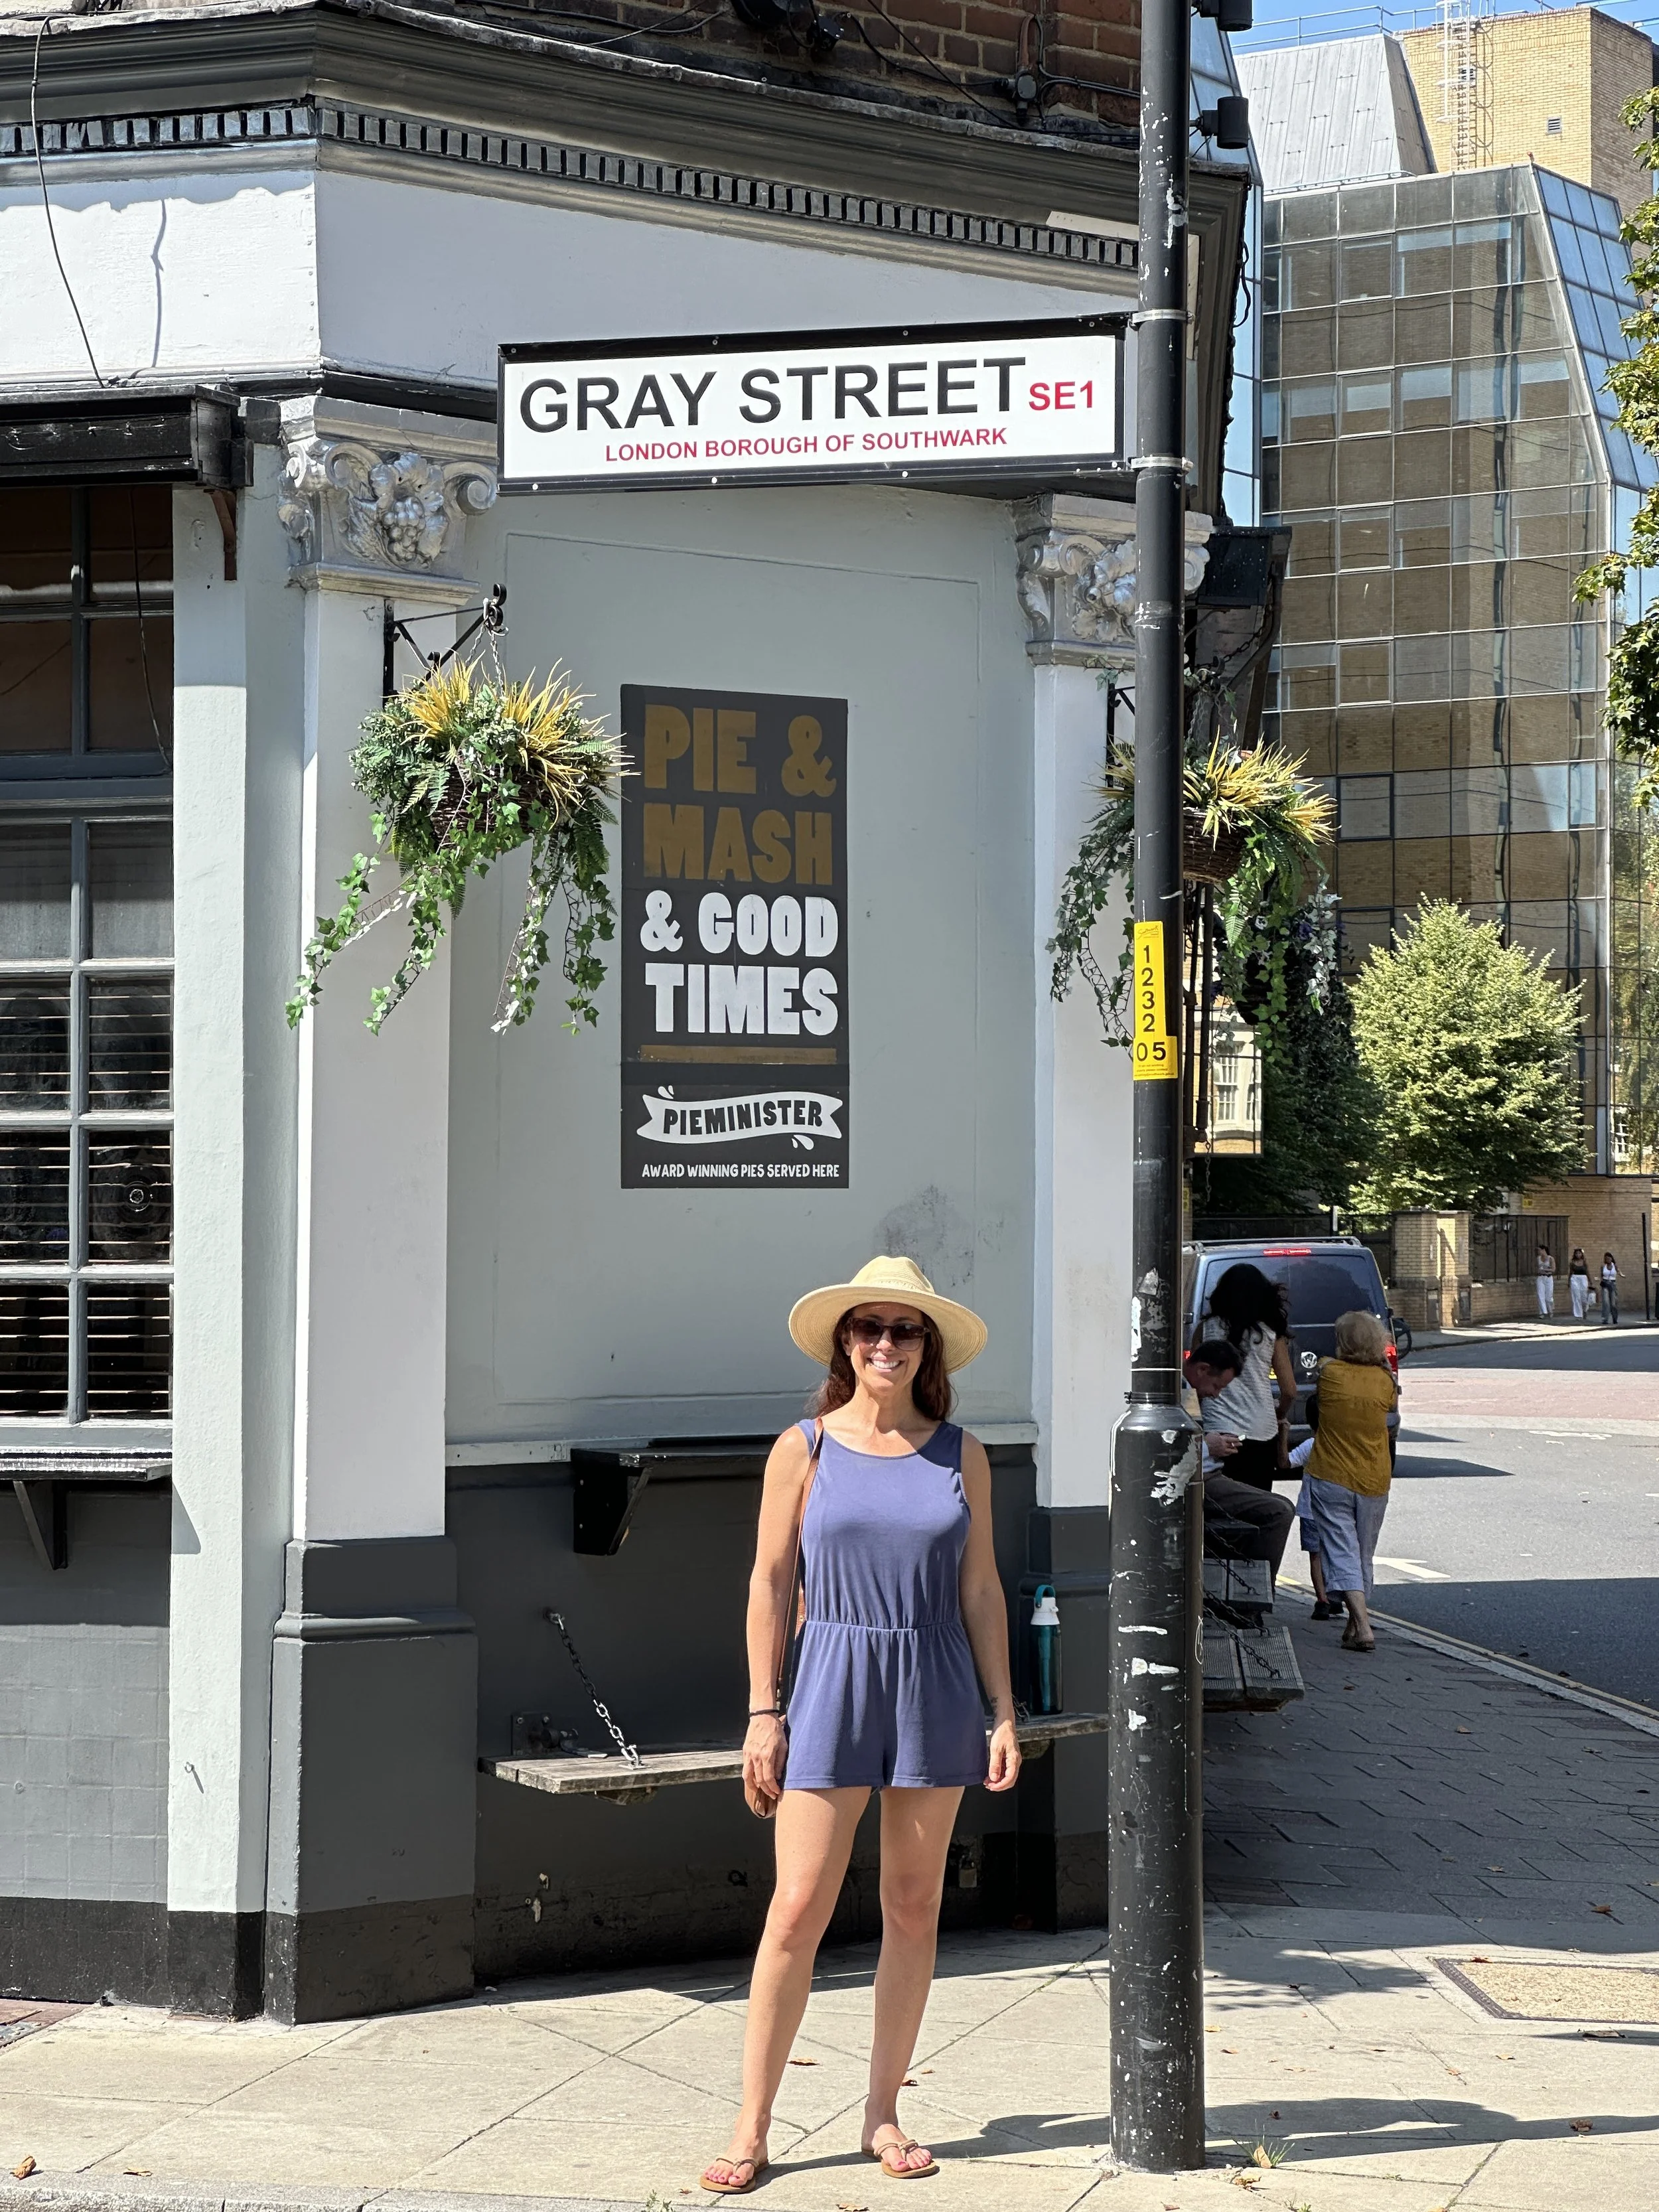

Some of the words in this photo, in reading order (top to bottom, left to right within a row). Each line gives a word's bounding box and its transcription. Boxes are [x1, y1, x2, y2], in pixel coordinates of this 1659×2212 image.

[520, 371, 717, 433] GRAY
[739, 356, 1026, 424] STREET
[1028, 380, 1093, 411] SE1
[605, 441, 697, 463] LONDON
[705, 436, 818, 457] BOROUGH
[826, 434, 855, 453] OF
[862, 427, 1007, 451] SOUTHWARK
[644, 703, 757, 794] PIE
[780, 715, 837, 797] &
[643, 802, 833, 885] MASH
[640, 889, 684, 952] &
[698, 891, 839, 957] GOOD
[644, 962, 839, 1036] TIMES
[1137, 1041, 1167, 1062] 05
[663, 1100, 823, 1136] PIEMINISTER
[641, 1163, 685, 1178] AWARD
[687, 1163, 739, 1178] WINNING
[741, 1163, 764, 1178] PIES
[766, 1163, 810, 1178] SERVED
[812, 1163, 839, 1178] HERE
